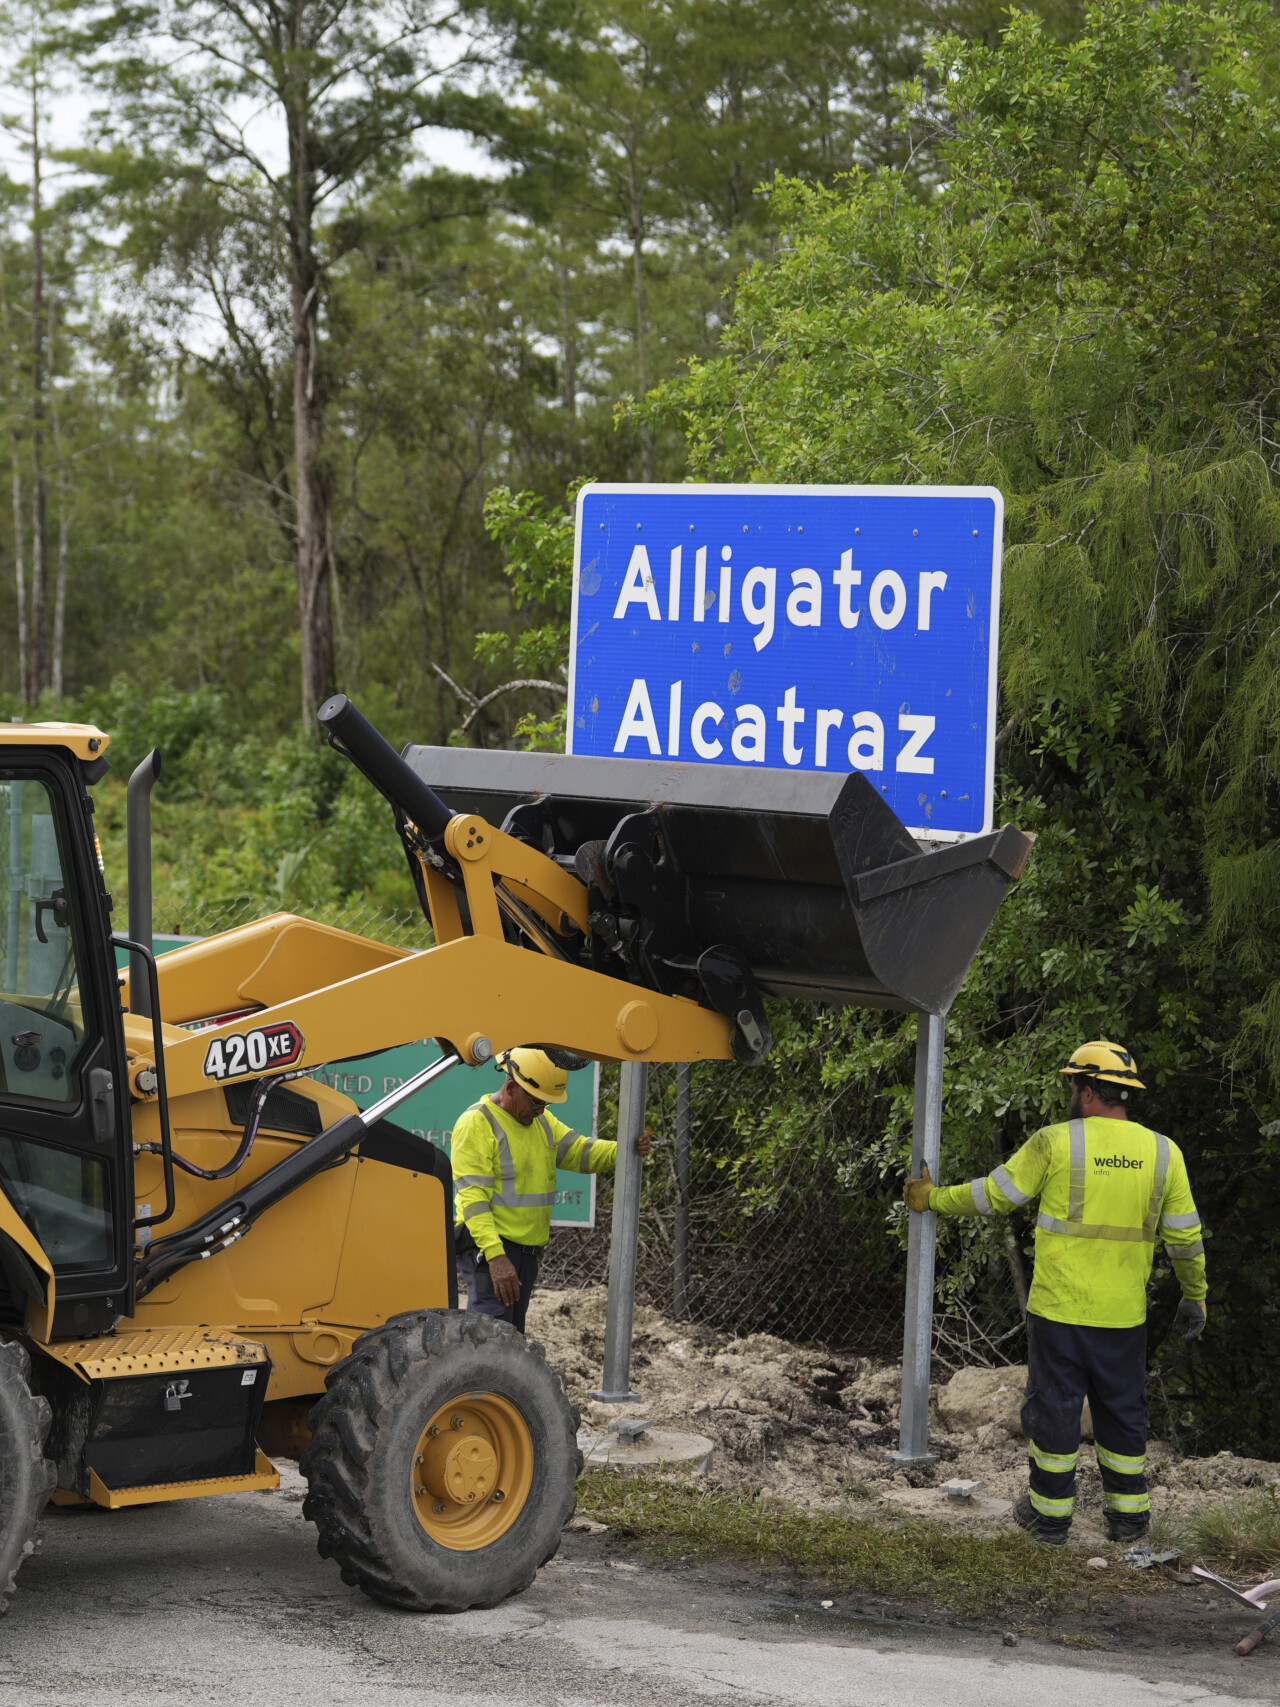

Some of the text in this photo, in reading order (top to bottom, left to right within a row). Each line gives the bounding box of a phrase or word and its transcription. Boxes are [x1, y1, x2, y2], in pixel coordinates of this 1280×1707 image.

[613, 544, 948, 652] Alligator
[613, 678, 936, 775] Alcatraz
[1094, 1154, 1144, 1169] webber
